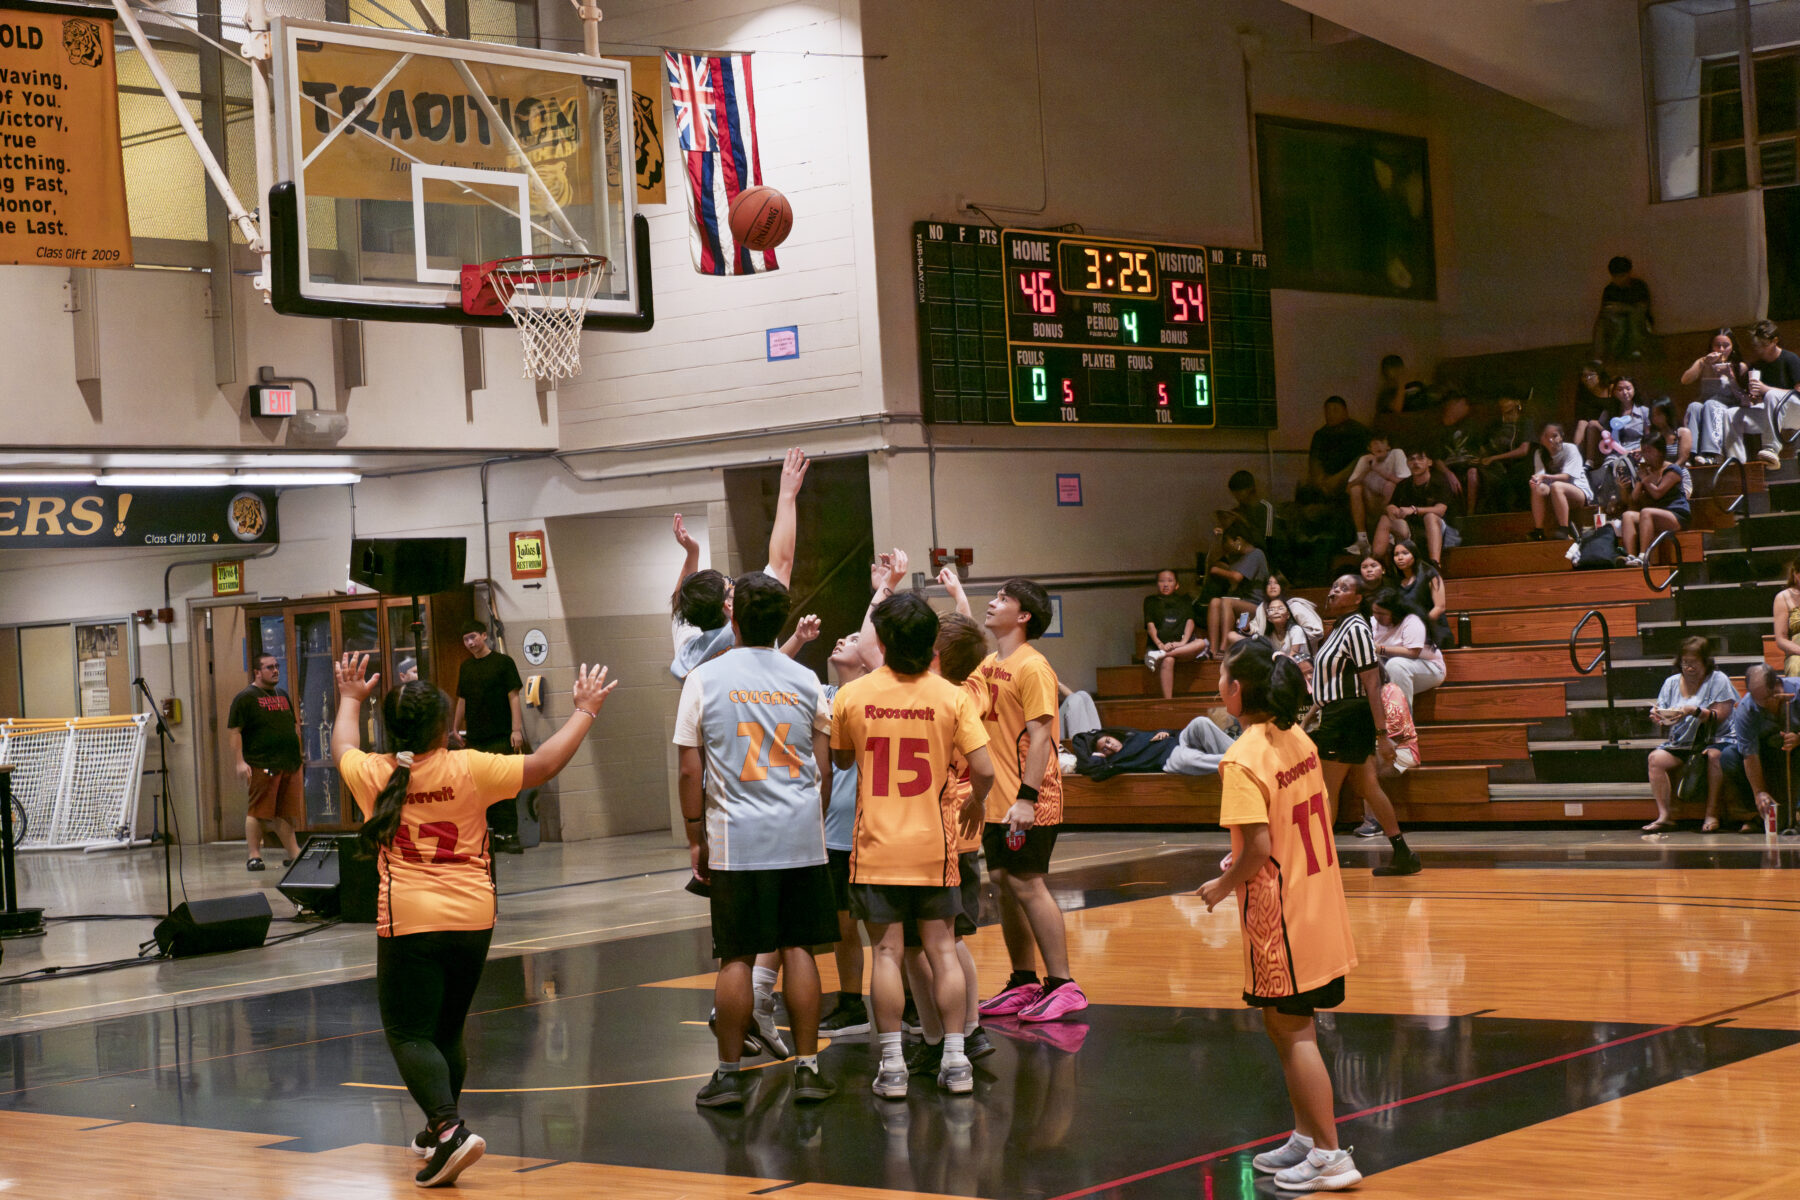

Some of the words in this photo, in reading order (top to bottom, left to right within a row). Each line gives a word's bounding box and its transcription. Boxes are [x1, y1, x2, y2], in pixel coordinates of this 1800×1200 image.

[22, 91, 61, 109] You.
[25, 177, 68, 196] Fast,
[27, 219, 68, 237] Last.
[929, 224, 943, 241] NO
[959, 226, 966, 242] F
[979, 228, 998, 245] PTS
[36, 247, 63, 259] Class
[65, 247, 88, 261] Gift
[92, 249, 120, 261] 2009
[1012, 239, 1051, 262] HOME
[1211, 249, 1224, 264] NO
[1235, 251, 1242, 265] F
[1252, 253, 1267, 268] PTS
[1084, 247, 1152, 293] 3:25
[1157, 251, 1204, 274] VISITOR
[1019, 271, 1056, 314] 46
[1171, 281, 1204, 322] 54
[1092, 302, 1111, 314] POSS
[1033, 322, 1064, 339] BONUS
[1086, 315, 1119, 331] PERIOD
[1123, 311, 1138, 344] 4
[1160, 329, 1188, 345] BONUS
[1016, 350, 1045, 366] FOULS
[1082, 353, 1116, 369] PLAYER
[1127, 355, 1153, 370] FOULS
[1180, 356, 1206, 371] FOULS
[1032, 367, 1048, 401] 0
[1062, 379, 1074, 403] 5
[1195, 374, 1209, 406] 0
[269, 391, 292, 413] EXIT
[1157, 383, 1168, 405] 5
[1060, 406, 1079, 422] TOL
[1156, 409, 1173, 424] TOL
[144, 534, 167, 545] Class
[169, 533, 185, 544] Gift
[187, 532, 207, 543] 2012
[728, 689, 800, 706] COUGARS
[864, 704, 935, 721] Roosevelt
[736, 721, 805, 782] 24
[864, 736, 933, 797] 15
[1292, 791, 1334, 877] 11
